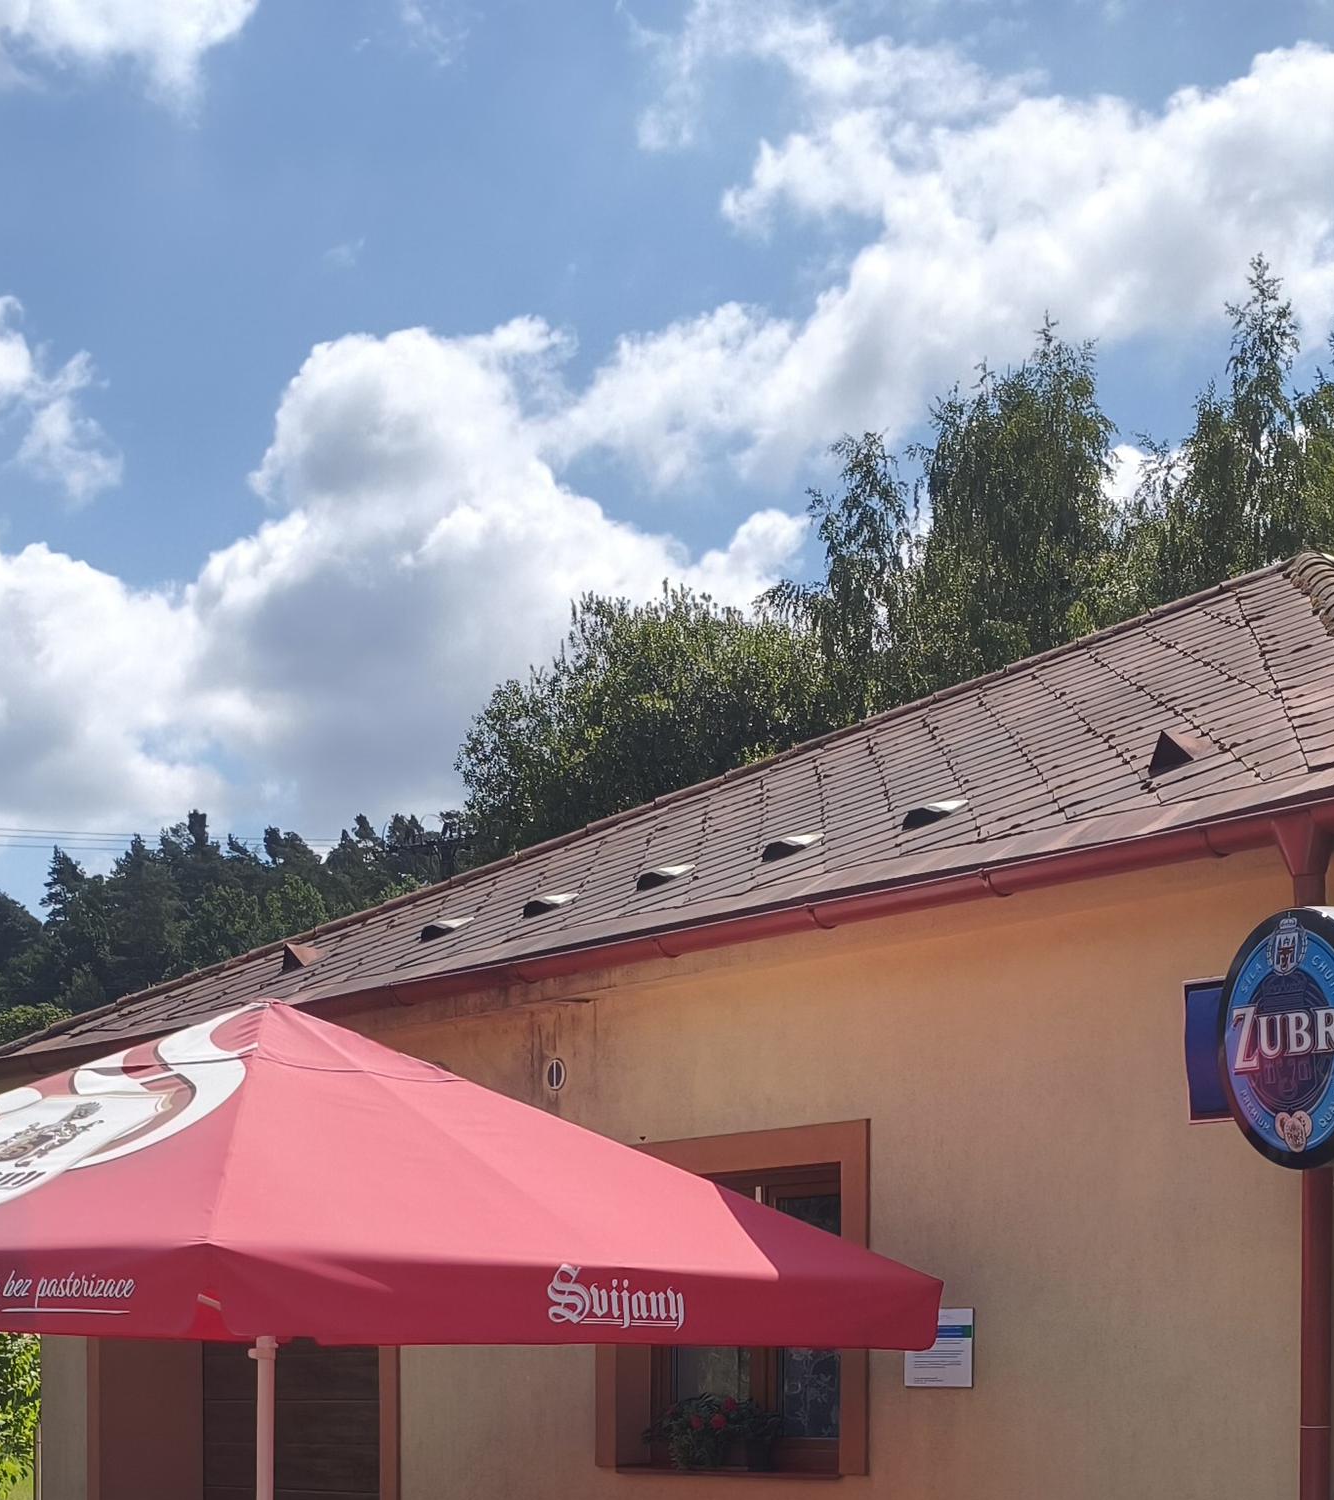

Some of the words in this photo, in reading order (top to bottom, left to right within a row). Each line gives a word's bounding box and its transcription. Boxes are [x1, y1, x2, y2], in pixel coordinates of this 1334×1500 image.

[1239, 1087, 1271, 1131] PREMIUM
[3, 1270, 30, 1298] bez
[34, 1272, 135, 1308] pasterizace
[547, 1263, 685, 1332] Svijany
